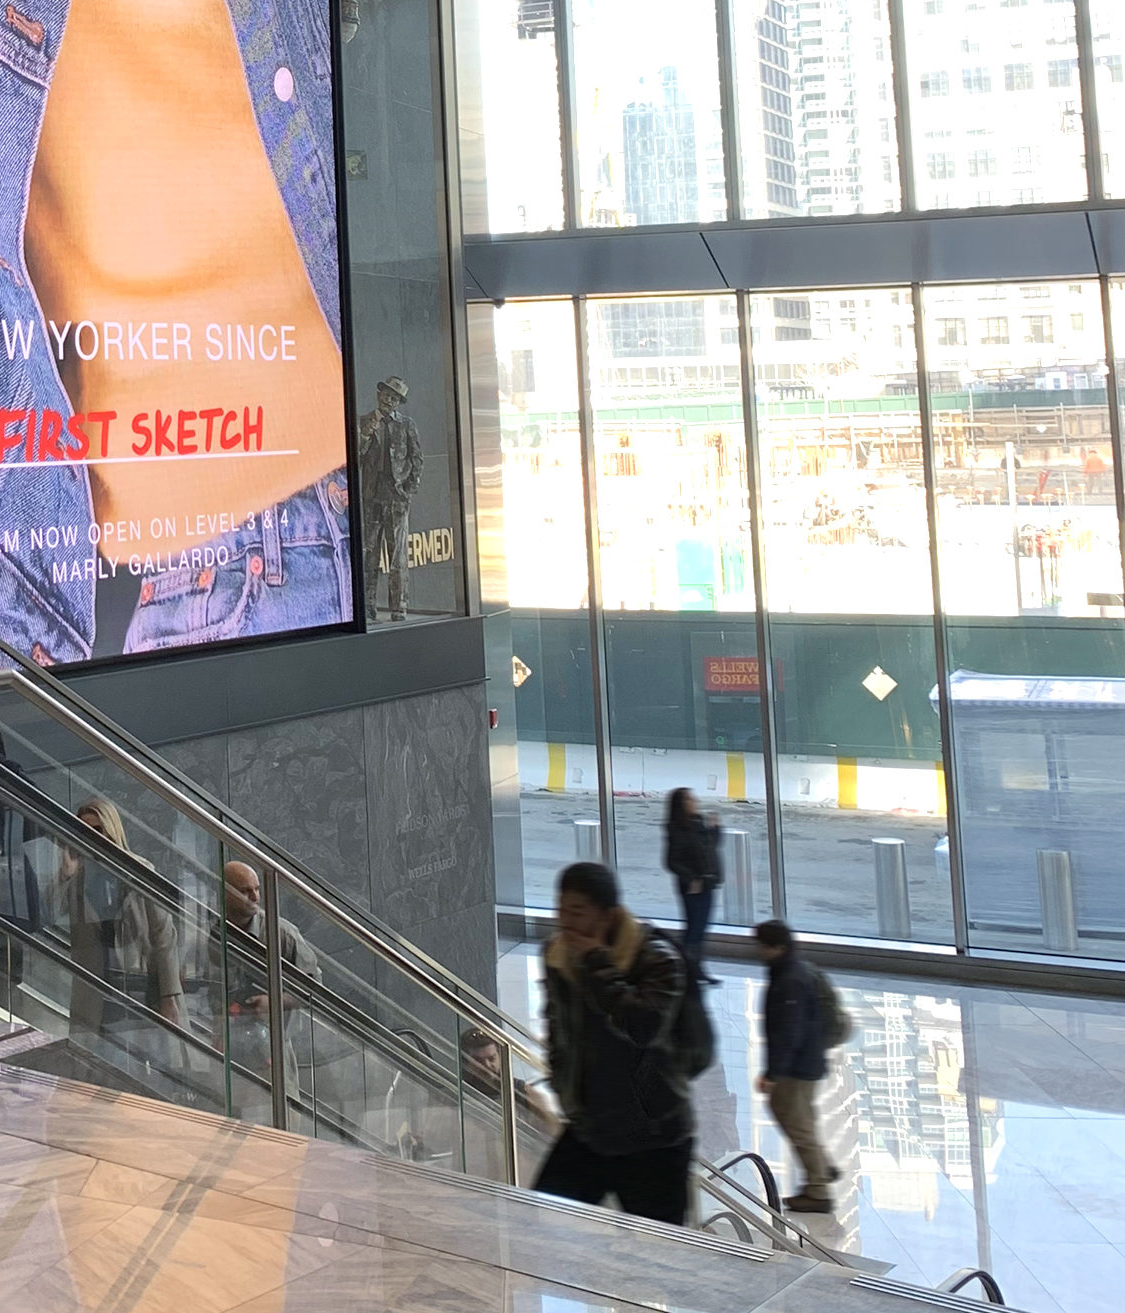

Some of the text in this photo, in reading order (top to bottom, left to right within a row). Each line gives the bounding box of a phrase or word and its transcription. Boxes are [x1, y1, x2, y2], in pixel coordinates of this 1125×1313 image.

[49, 320, 192, 361] YORKER
[205, 322, 297, 361] SINCE
[131, 405, 264, 457] SKETCH
[30, 524, 79, 550] NOW
[88, 517, 141, 544] OPEN
[150, 515, 177, 538] ON
[185, 512, 240, 537] LEVEL
[246, 510, 257, 531] 3
[263, 508, 275, 530] &
[280, 507, 289, 529] 4
[52, 544, 229, 584] MARLY GALLARDO
